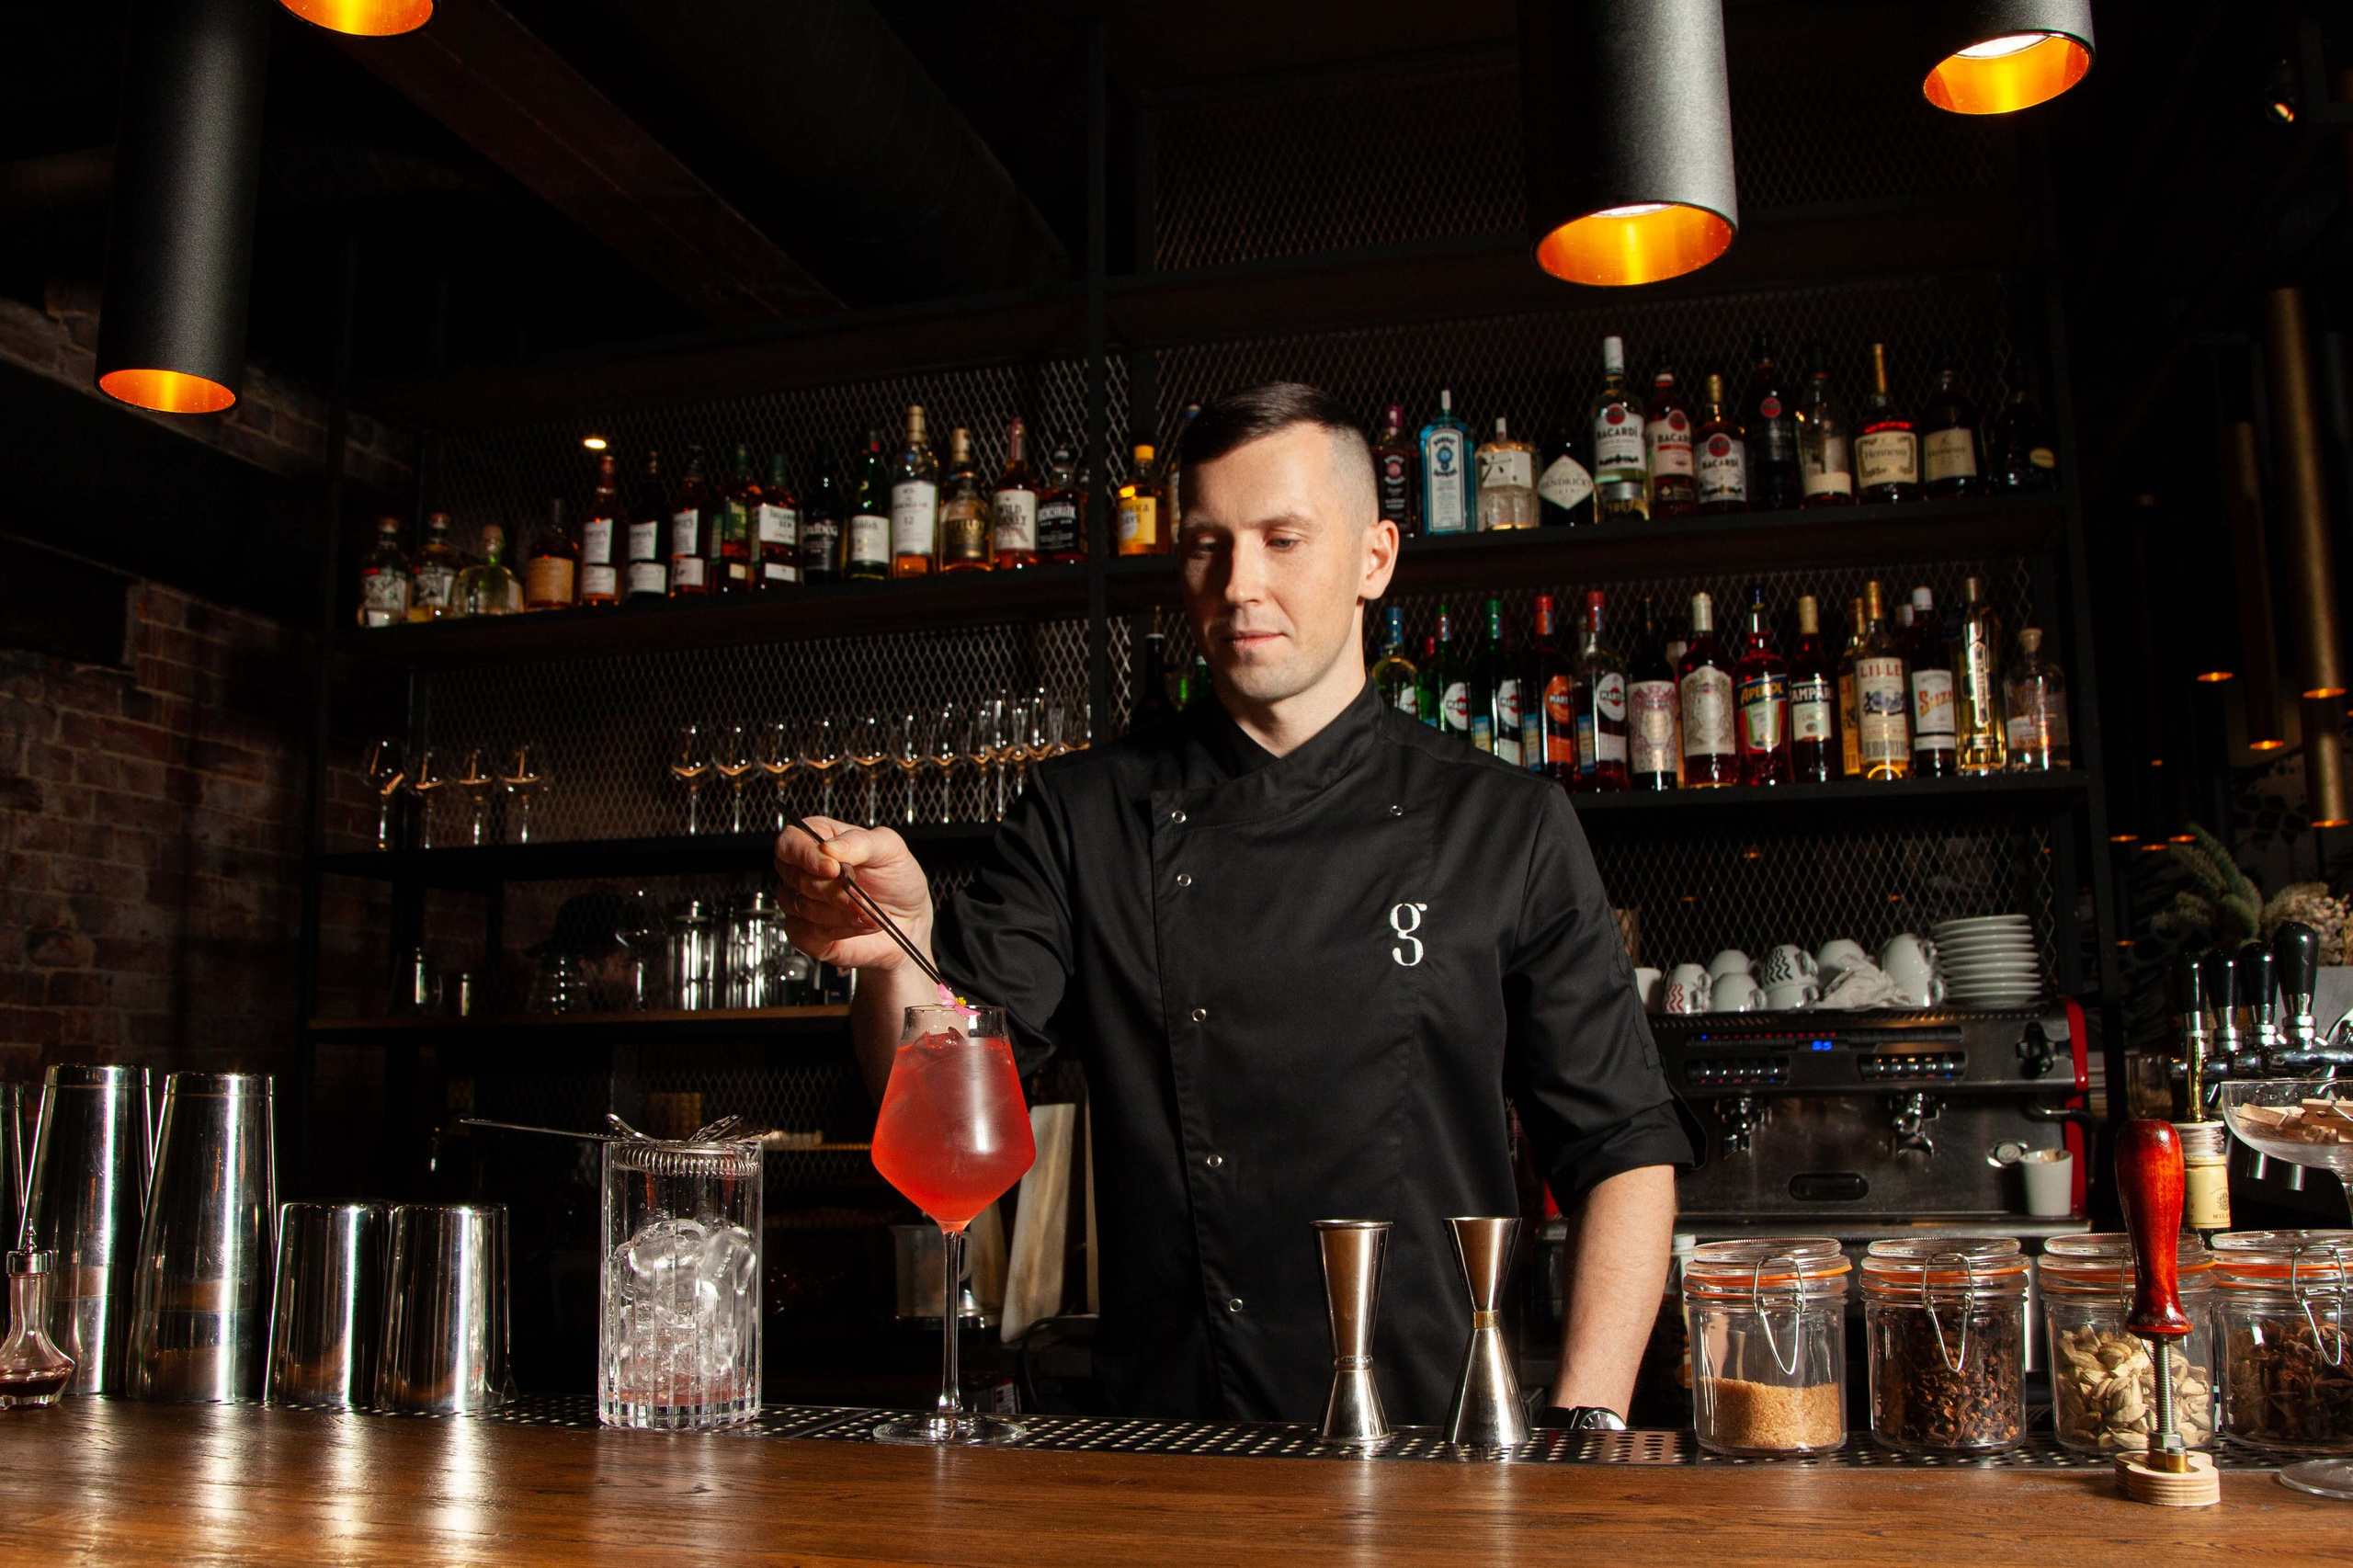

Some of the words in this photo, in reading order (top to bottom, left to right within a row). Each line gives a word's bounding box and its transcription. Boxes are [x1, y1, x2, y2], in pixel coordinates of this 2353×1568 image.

[1865, 447, 1908, 459] Hennessy
[1859, 664, 1904, 677] LILLE
[1740, 682, 1783, 706] APEROL
[1389, 903, 1427, 966] g
